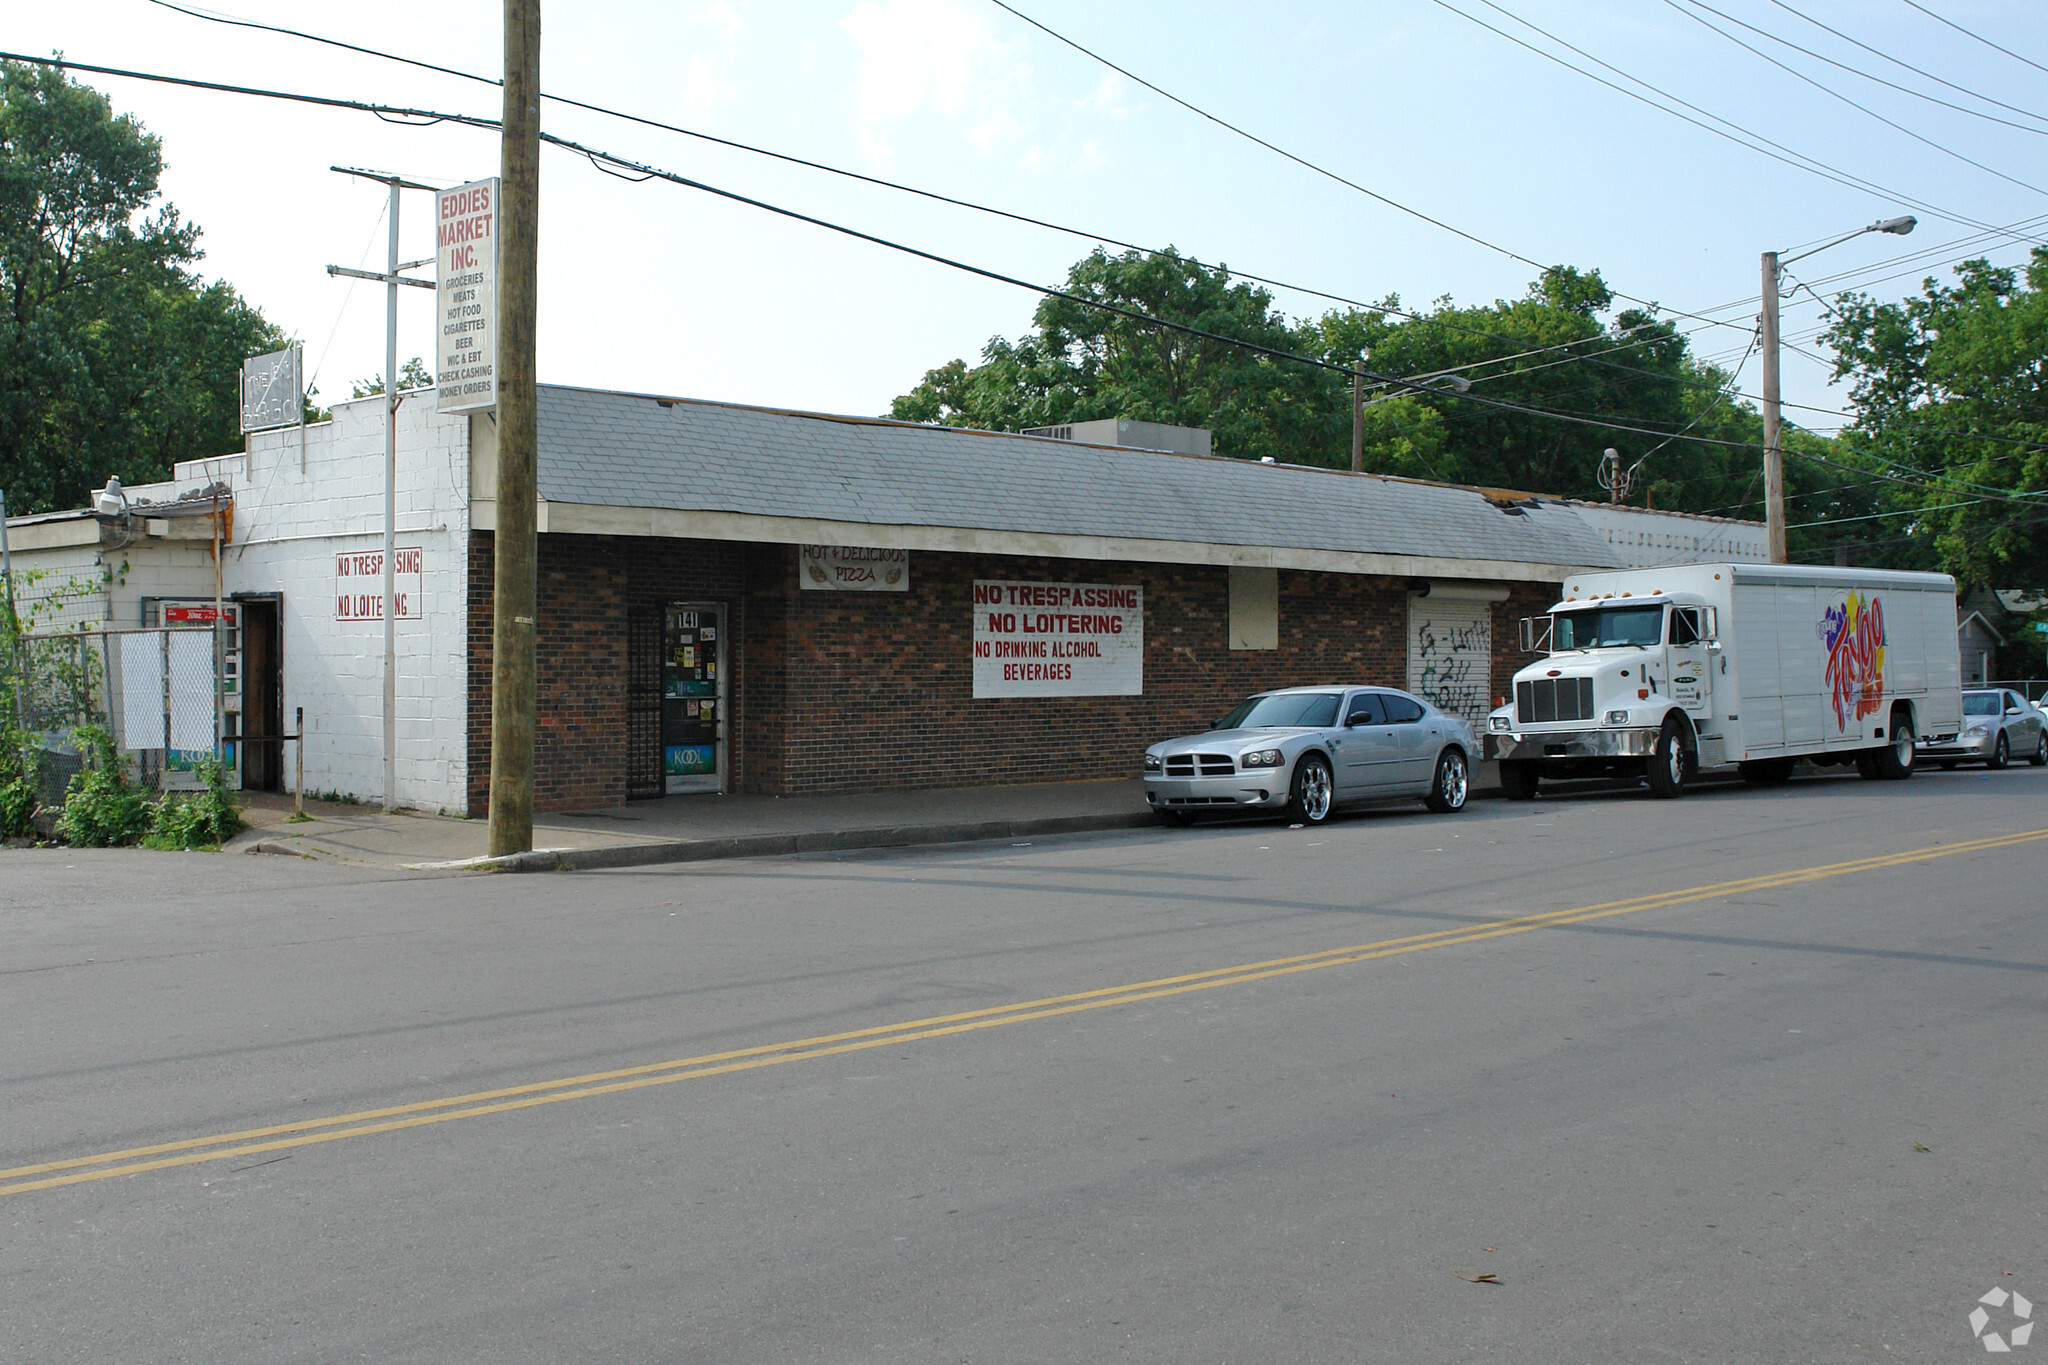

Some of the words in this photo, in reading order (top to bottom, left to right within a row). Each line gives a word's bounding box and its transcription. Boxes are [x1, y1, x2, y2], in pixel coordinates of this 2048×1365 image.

[441, 187, 489, 220] EDDIES
[437, 213, 493, 249] MARKET
[451, 244, 478, 272] INC.
[445, 272, 484, 290] GROCERIES
[452, 289, 476, 304] MEATS
[447, 307, 461, 320] HOT
[462, 303, 482, 317] FOOD
[443, 318, 486, 336] CIGARETTES
[455, 336, 474, 350] BEER
[447, 354, 460, 367] WIC
[461, 353, 467, 365] &
[468, 350, 482, 364] EBT
[438, 369, 460, 384] CHECK
[461, 364, 493, 379] CASHING
[439, 385, 462, 399] MONEY
[463, 380, 492, 396] ORDERS
[803, 544, 830, 560] HOT
[842, 546, 906, 562] DELICIOUS
[338, 557, 350, 577] NO
[353, 550, 420, 576] TRESPSING
[835, 566, 876, 582] PIZZA
[338, 594, 350, 617] NO
[353, 592, 408, 618] LOITENG
[974, 584, 1002, 605] NO
[1006, 585, 1138, 609] TRESPASSING
[680, 612, 697, 627] 141
[989, 612, 1016, 633] NO
[1023, 613, 1123, 634] LOITERING
[975, 641, 990, 658] NO
[995, 640, 1047, 658] DRINKING
[1051, 641, 1102, 658] ALCOHOL
[1003, 663, 1072, 681] BEVERAGES
[674, 749, 703, 765] KOOL
